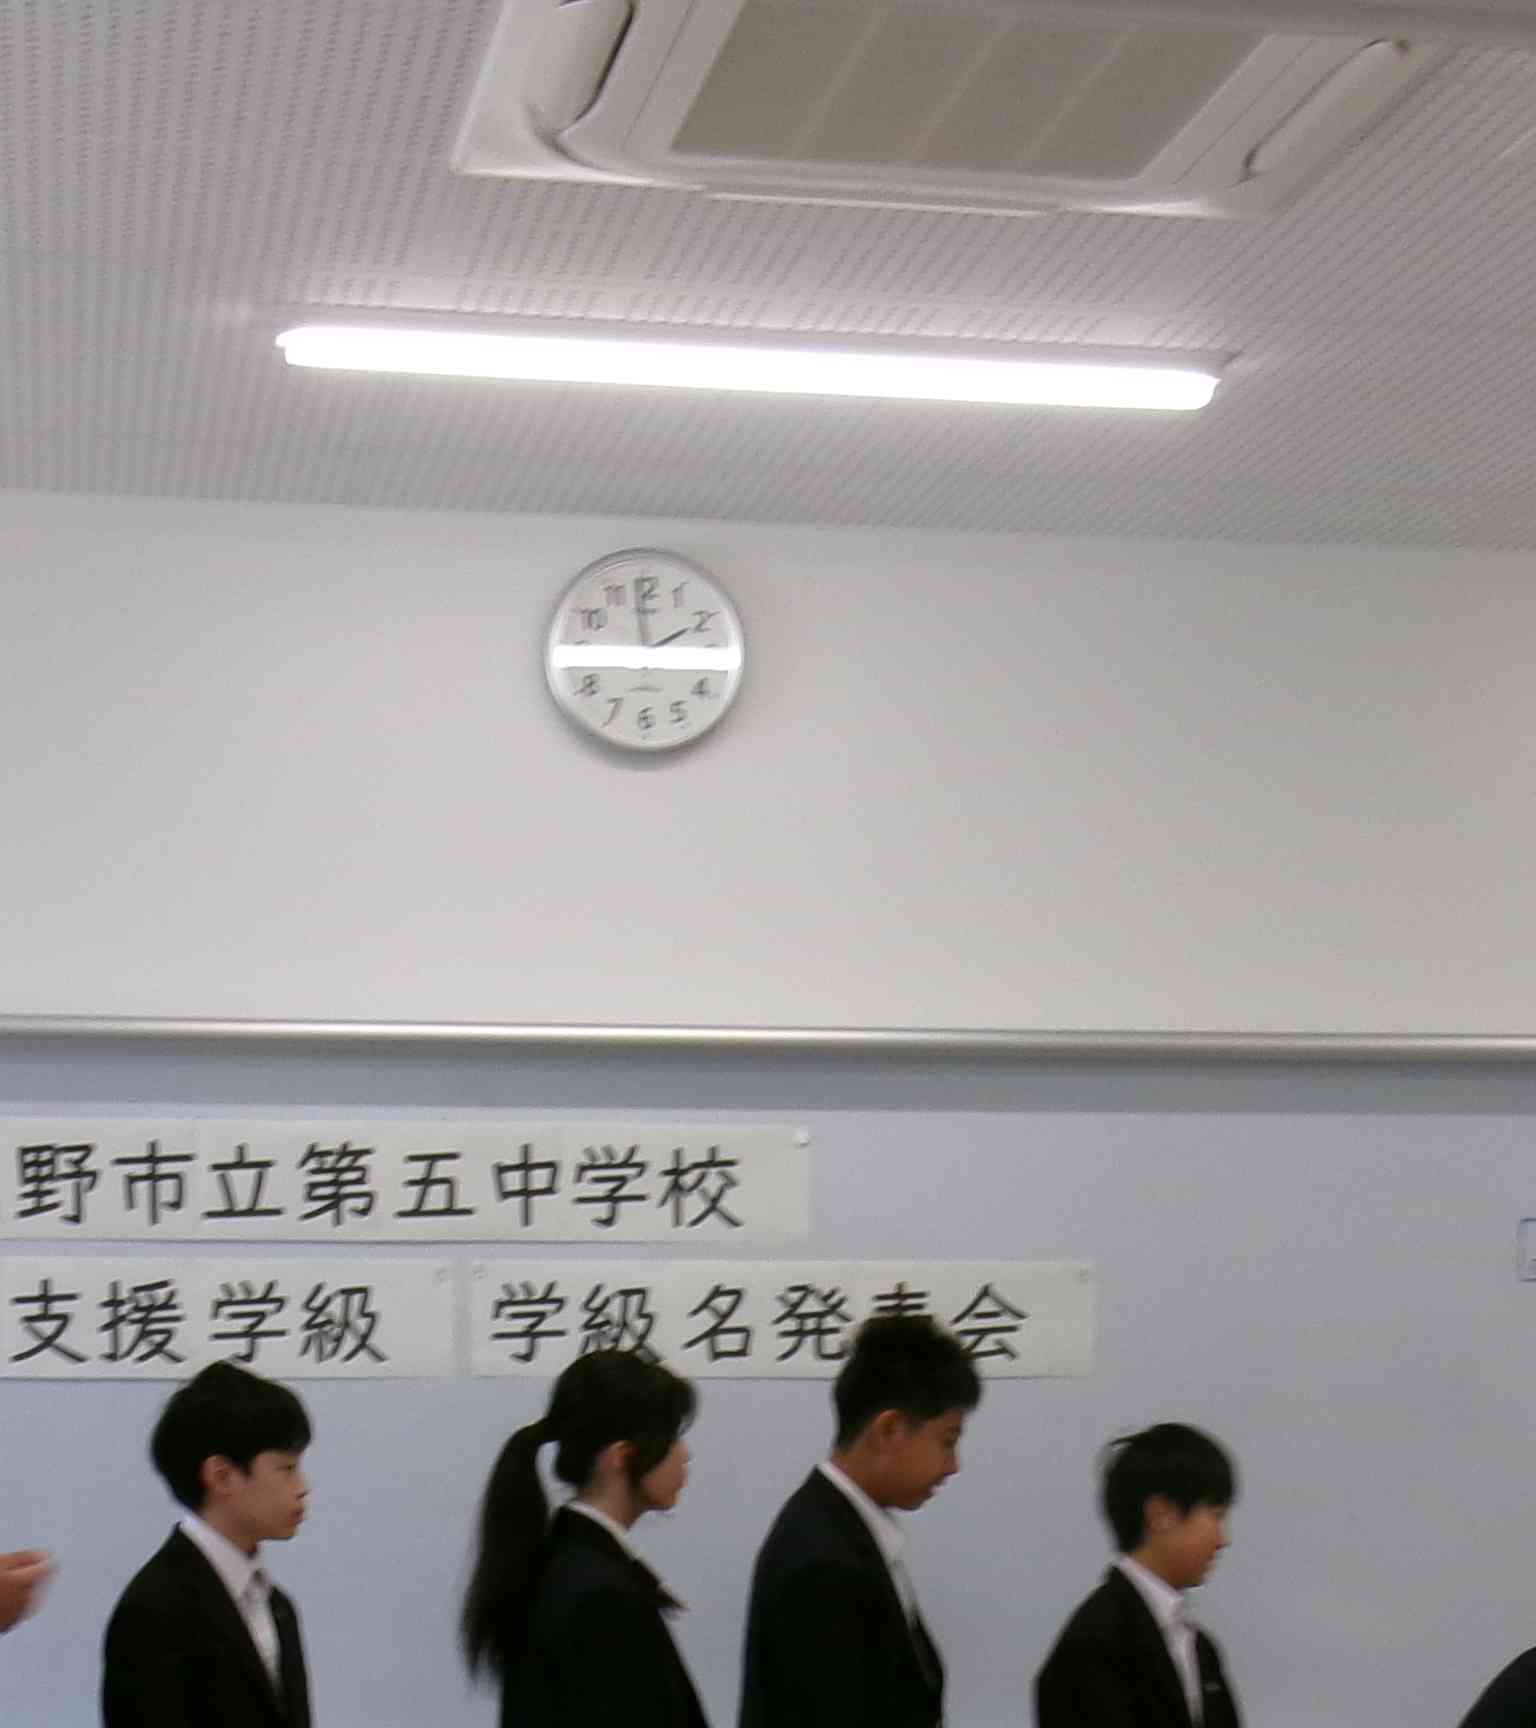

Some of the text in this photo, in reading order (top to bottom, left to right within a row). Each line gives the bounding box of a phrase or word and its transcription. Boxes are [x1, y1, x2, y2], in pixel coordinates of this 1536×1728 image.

[692, 609, 720, 634] 2
[576, 673, 601, 697] 8
[691, 677, 716, 699] 4
[601, 697, 624, 727] 7
[637, 706, 656, 730] 6
[669, 700, 688, 724] 5
